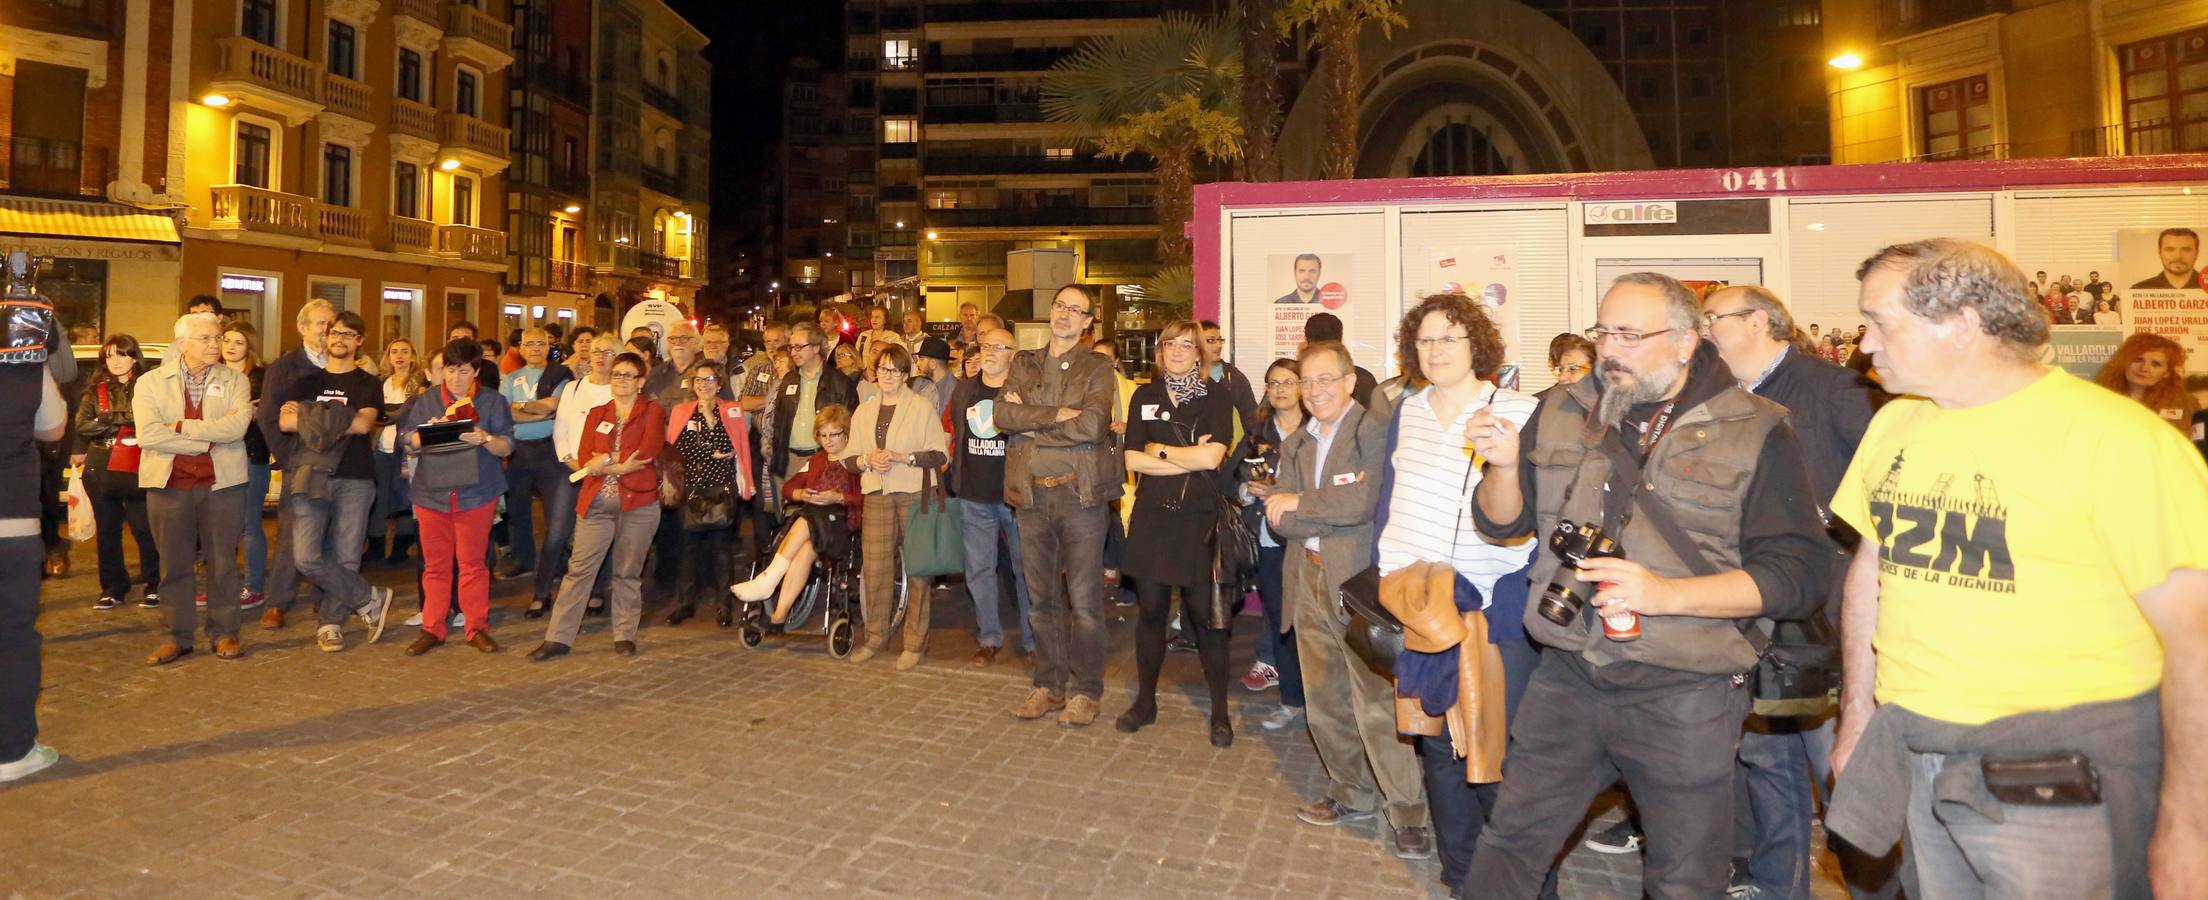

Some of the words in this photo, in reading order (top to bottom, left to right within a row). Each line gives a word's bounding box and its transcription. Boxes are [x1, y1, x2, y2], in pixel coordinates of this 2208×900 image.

[1722, 168, 1787, 191] 041
[1611, 204, 1674, 221] alfe
[2133, 299, 2176, 310] ALBERTO
[1274, 311, 1305, 321] ALBERTO
[2134, 316, 2153, 325] JUAN
[1904, 567, 1917, 580] DE
[1925, 571, 1940, 584] LA
